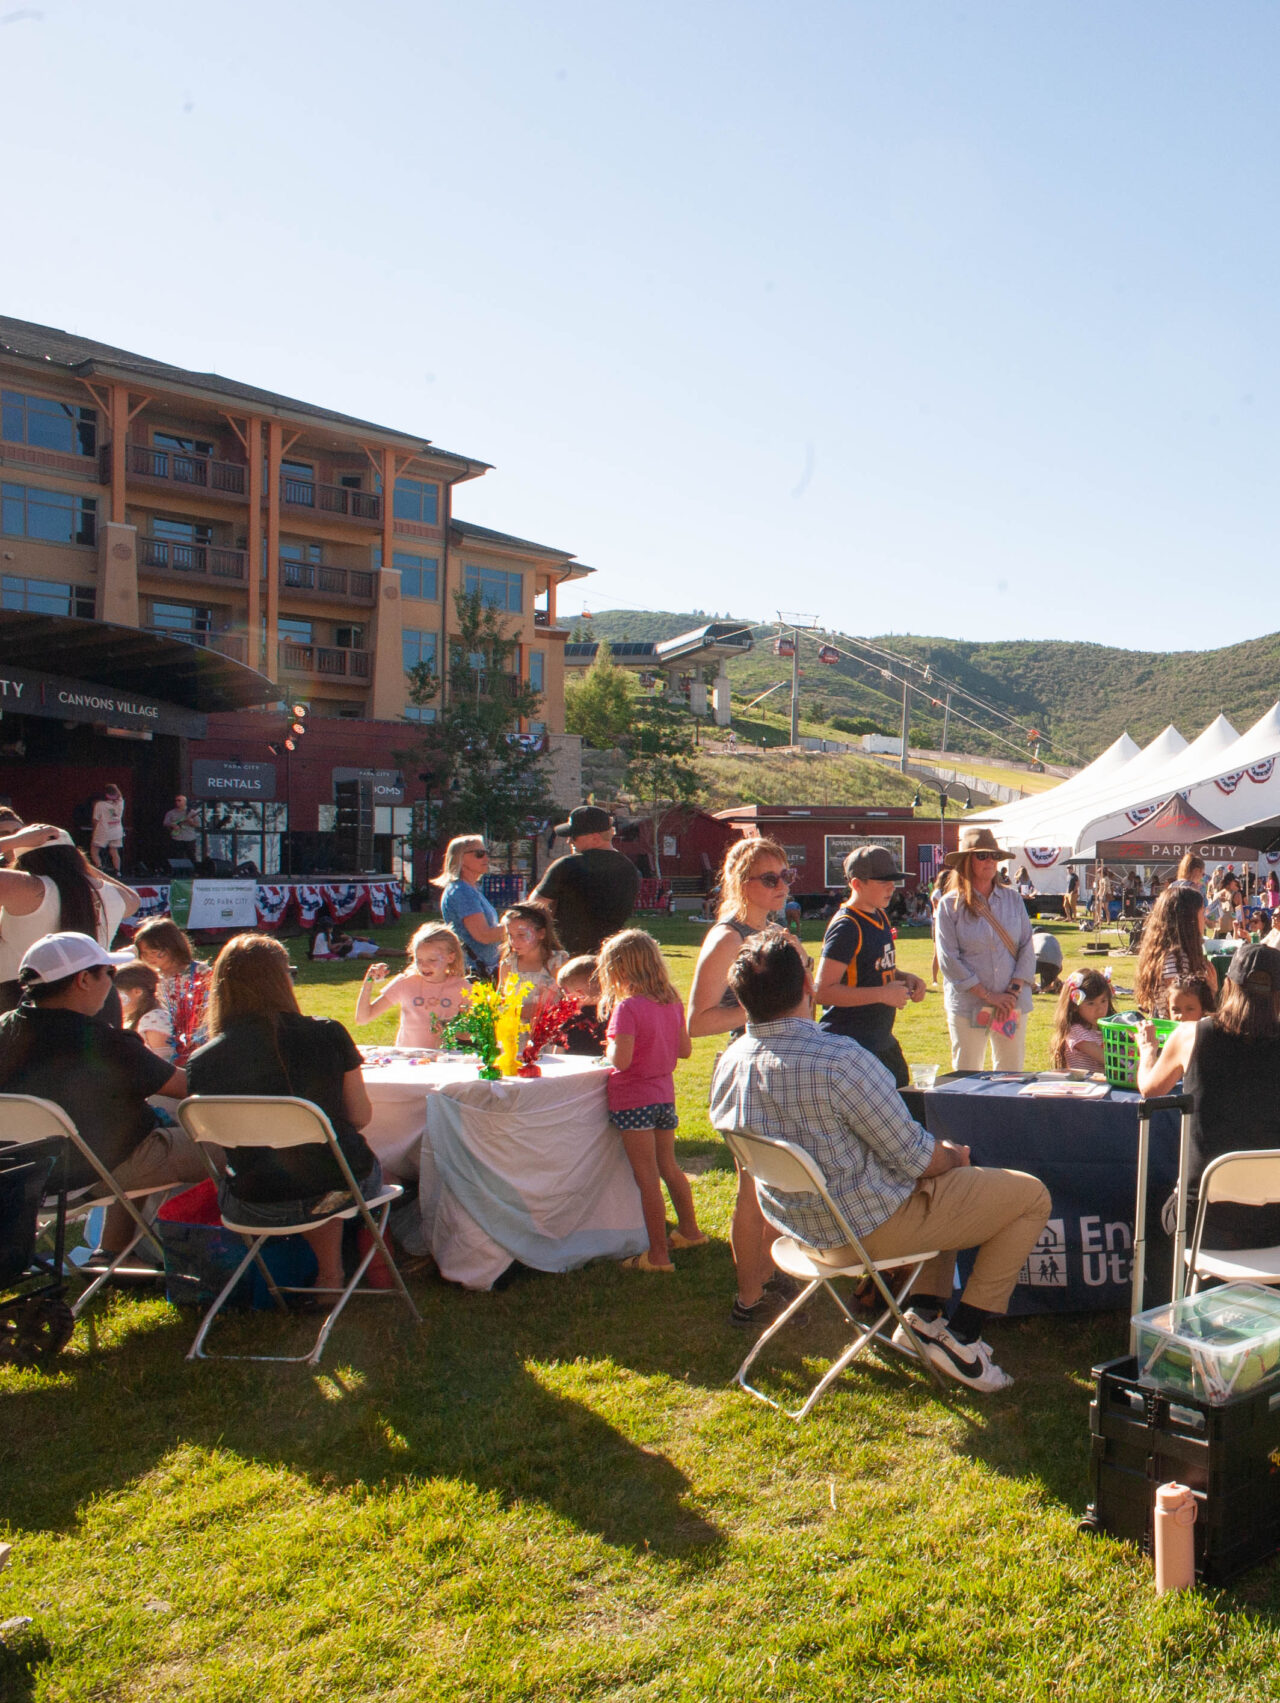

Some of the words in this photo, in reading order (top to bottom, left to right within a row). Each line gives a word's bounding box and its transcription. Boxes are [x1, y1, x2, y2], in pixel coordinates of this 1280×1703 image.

[58, 691, 113, 711] CANYONS
[116, 701, 159, 718] VILLAGE
[208, 777, 262, 789] RENTALS
[374, 785, 401, 795] OMS
[1151, 844, 1192, 856] PARK
[1200, 845, 1237, 857] CITY
[1079, 1215, 1135, 1252] En
